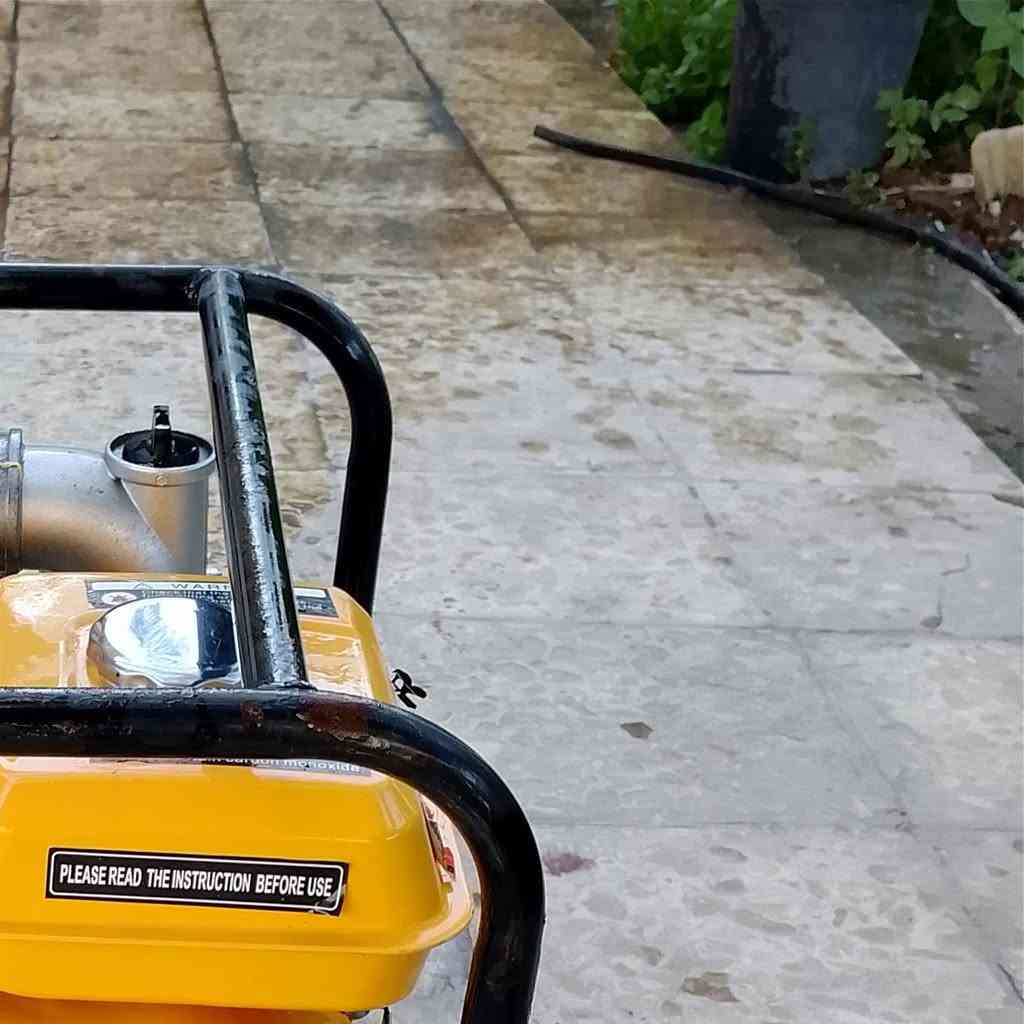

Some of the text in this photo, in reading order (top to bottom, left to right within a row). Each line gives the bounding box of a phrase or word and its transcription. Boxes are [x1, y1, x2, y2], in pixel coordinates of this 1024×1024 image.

[59, 863, 333, 897] PLEASE READ THE INSTRUCTION BEFORE USE
